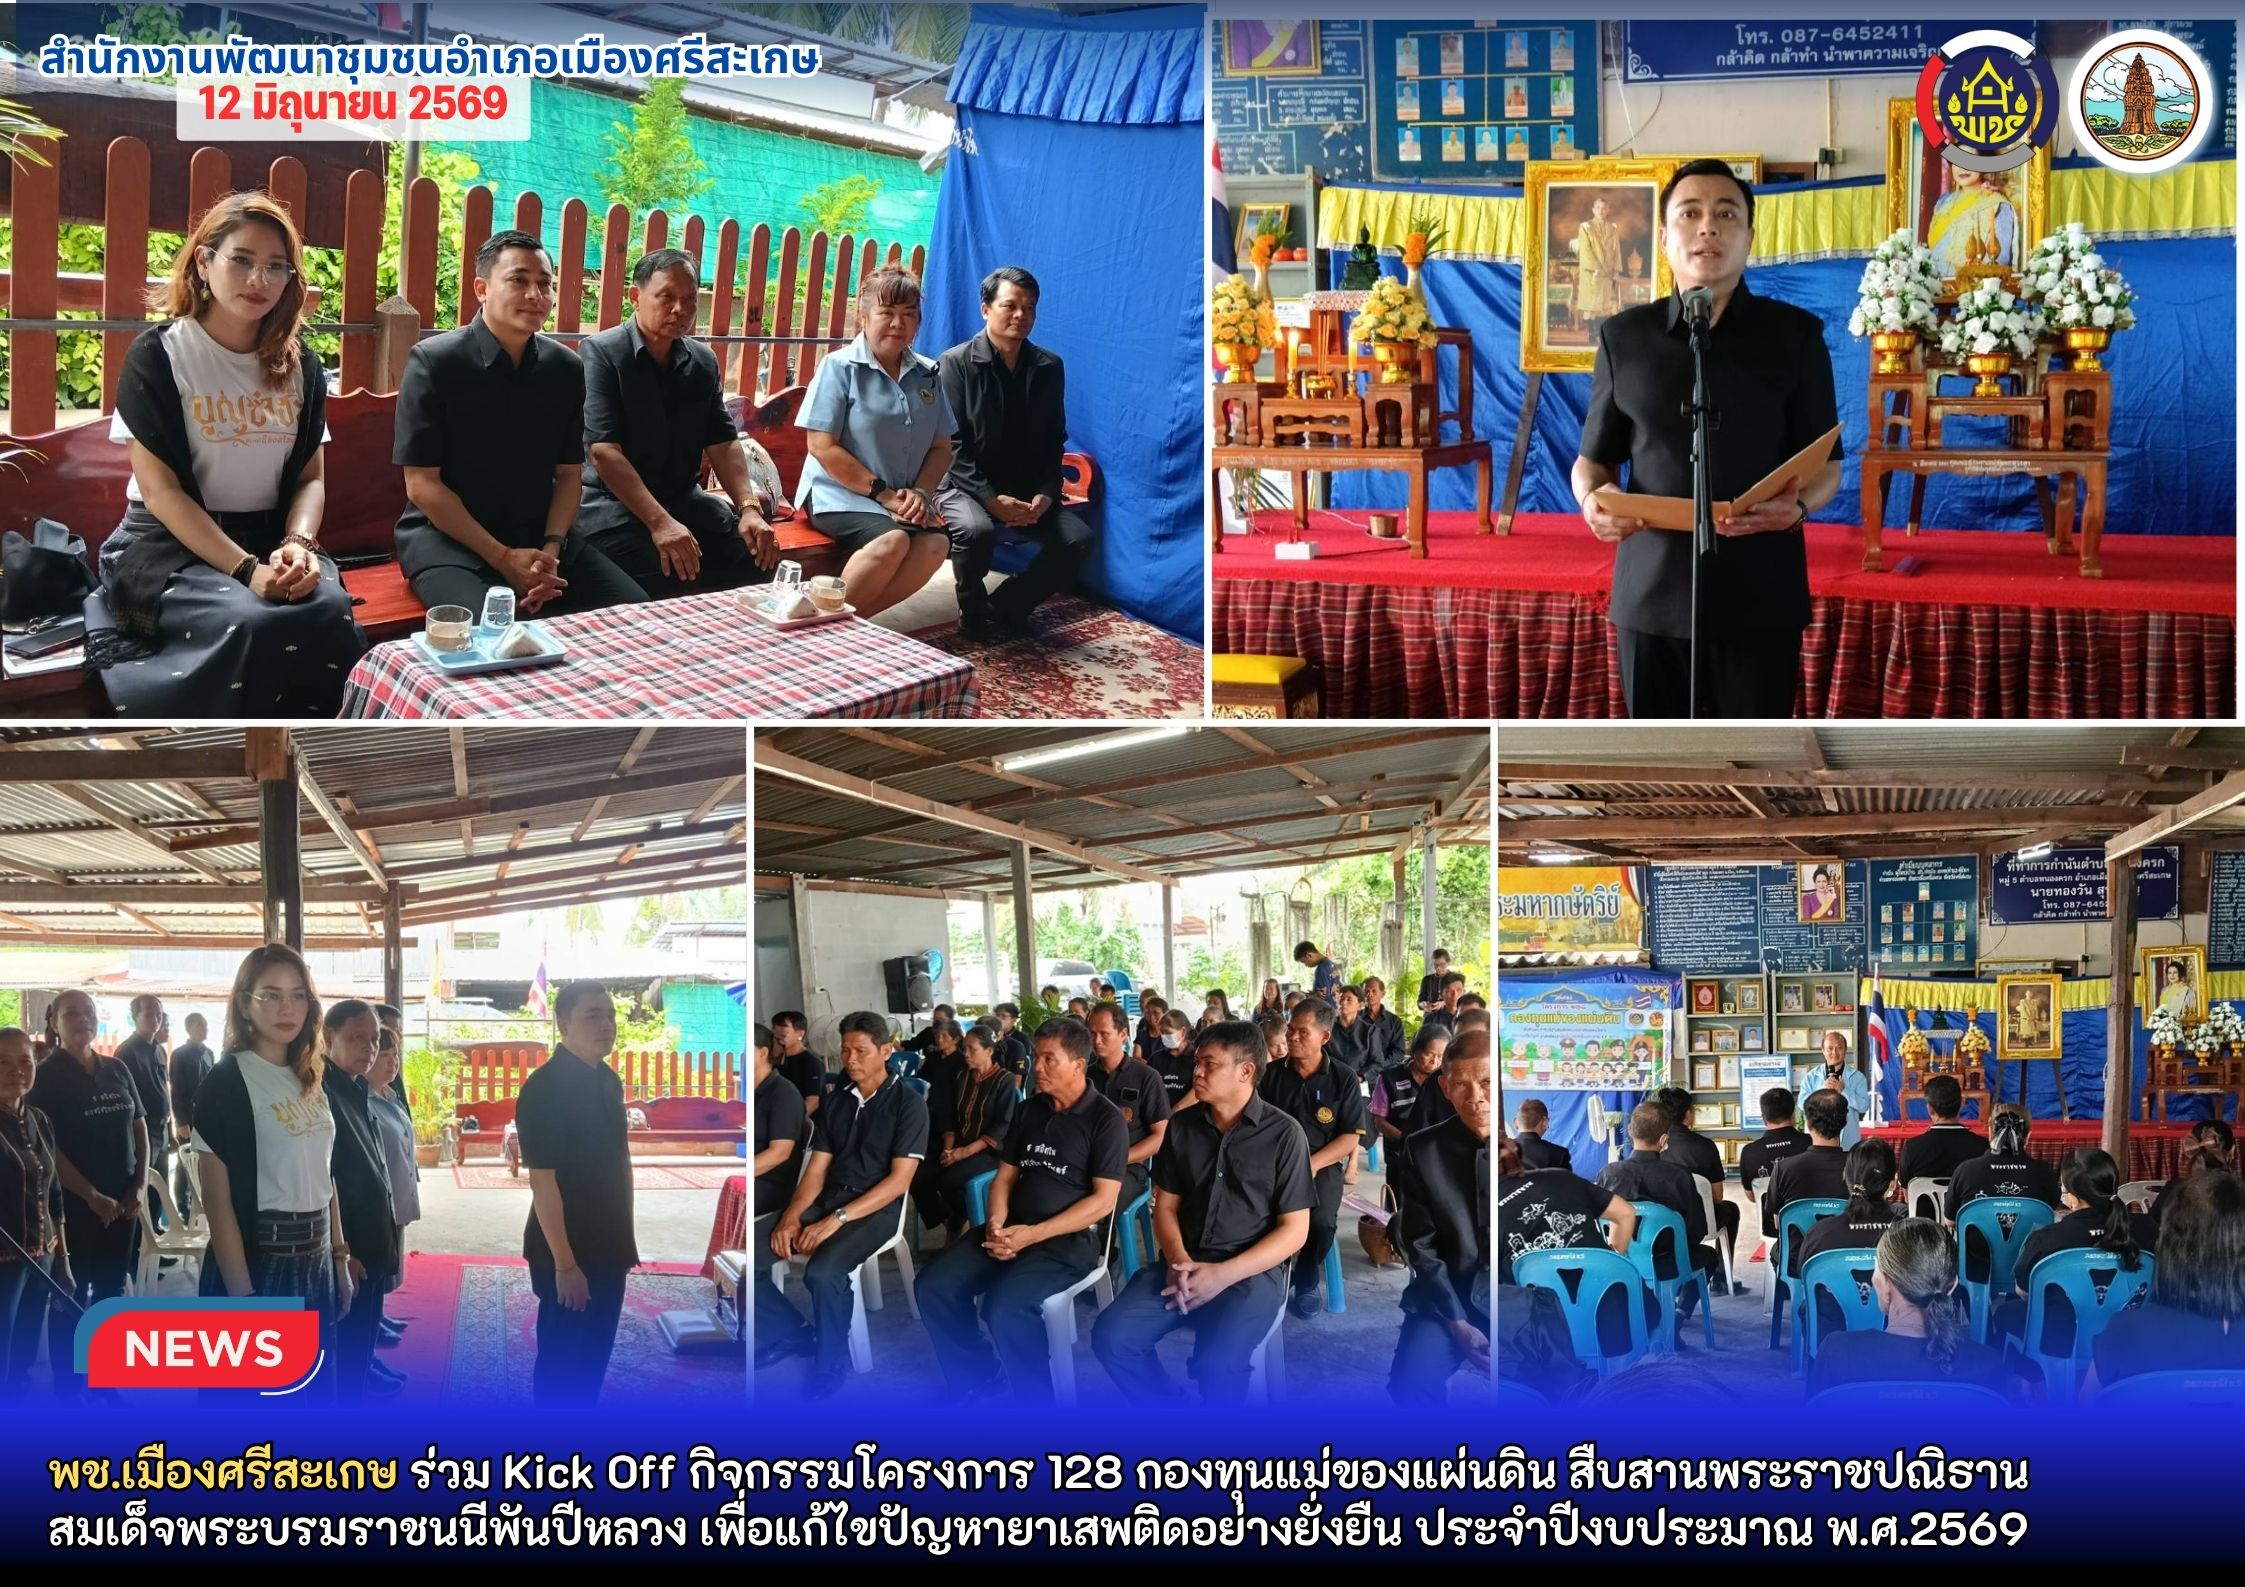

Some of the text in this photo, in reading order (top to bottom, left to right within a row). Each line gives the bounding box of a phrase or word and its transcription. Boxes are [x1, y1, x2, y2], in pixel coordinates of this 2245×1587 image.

[1735, 24, 1922, 46] โทร. 087-6452411
[1716, 48, 1766, 67] กล้าคิด
[1770, 46, 1818, 64] กล้าทำ
[2012, 876, 2018, 884] 5
[2030, 882, 2093, 898] นายทองวัน
[2042, 899, 2061, 910] โทร.
